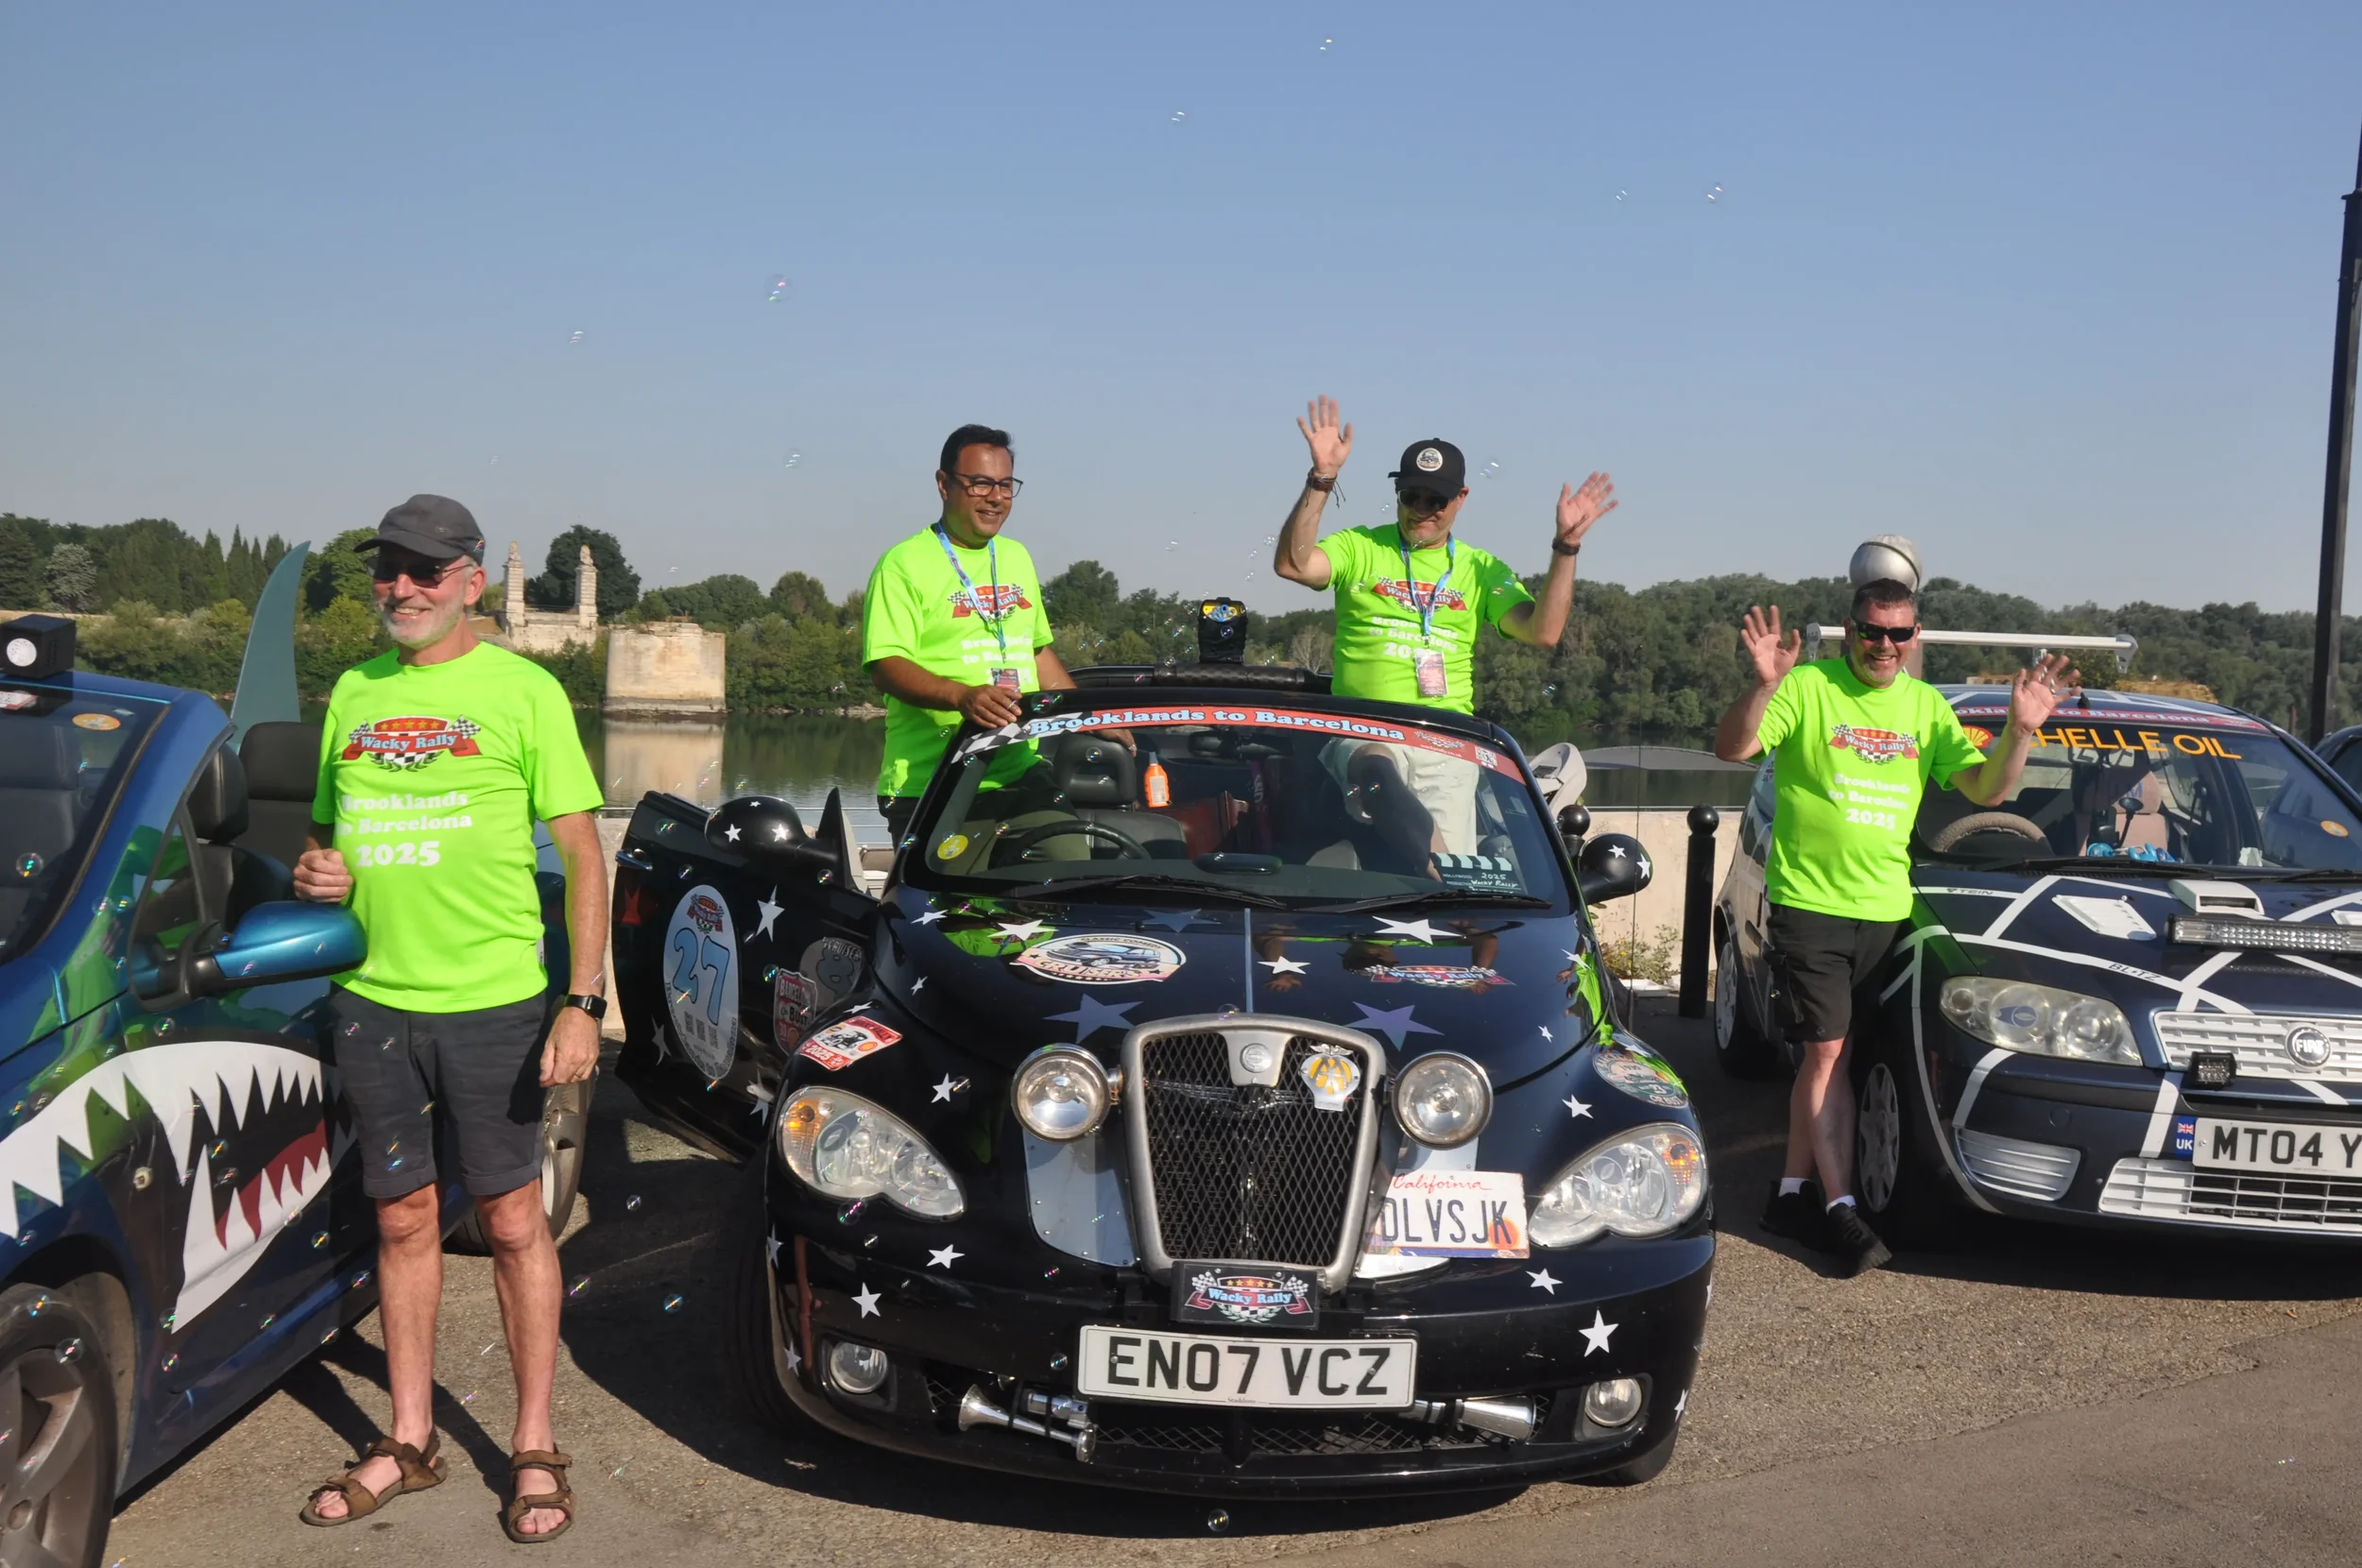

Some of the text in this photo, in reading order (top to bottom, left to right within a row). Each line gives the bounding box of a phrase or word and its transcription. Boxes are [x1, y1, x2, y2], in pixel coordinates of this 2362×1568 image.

[964, 600, 993, 610] Wcky
[1373, 616, 1458, 640] Brooands
[1029, 708, 1205, 736] Brooklands
[1212, 709, 1246, 722] to
[1255, 710, 1406, 741] Barcelona
[2088, 709, 2210, 724] Barcelona
[361, 734, 458, 752] Wacky Rally
[1844, 734, 1906, 752] Wacky Rally
[2031, 726, 2242, 759] HELLE OIL
[1828, 790, 1844, 801] to
[357, 815, 472, 835] Barcelona
[1845, 808, 1897, 830] 2025
[355, 840, 441, 867] 2025
[1481, 872, 1507, 880] 2025
[673, 927, 730, 1026] 27
[1037, 960, 1141, 979] CRUISERS
[1389, 971, 1442, 980] Wacky
[805, 1044, 834, 1061] 2025
[2296, 1038, 2325, 1055] FIAT
[2176, 1137, 2194, 1150] UK
[2213, 1125, 2323, 1167] MT04
[1393, 1172, 1494, 1194] California
[1208, 1287, 1292, 1304] Wacky Rally
[1107, 1335, 1391, 1396] EN07 VCZ
